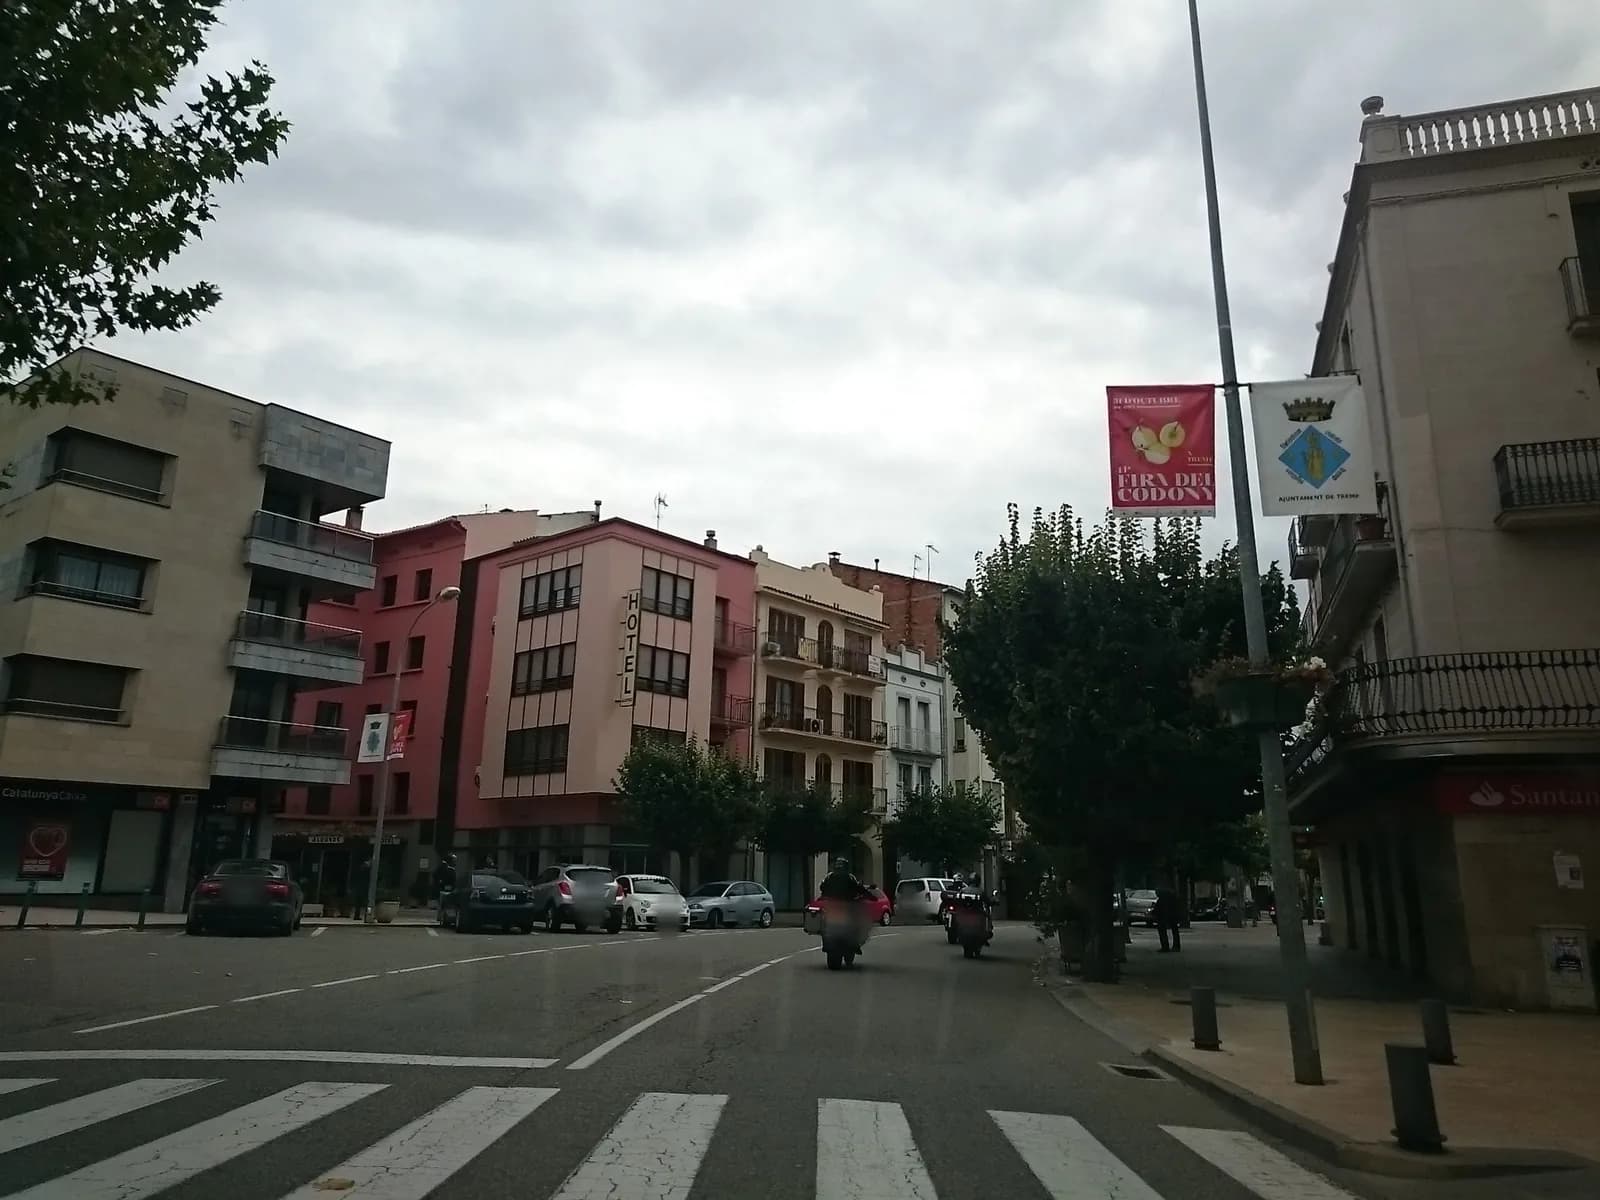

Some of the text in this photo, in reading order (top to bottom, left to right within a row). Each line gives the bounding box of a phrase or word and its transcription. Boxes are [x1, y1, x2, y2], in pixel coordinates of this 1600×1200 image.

[1118, 472, 1214, 487] FIRA DEL
[1117, 487, 1214, 502] CODONY
[1278, 494, 1323, 503] AJUNTAMENT
[624, 592, 639, 694] HOTEL
[1, 787, 88, 801] CatalunyaCaixa
